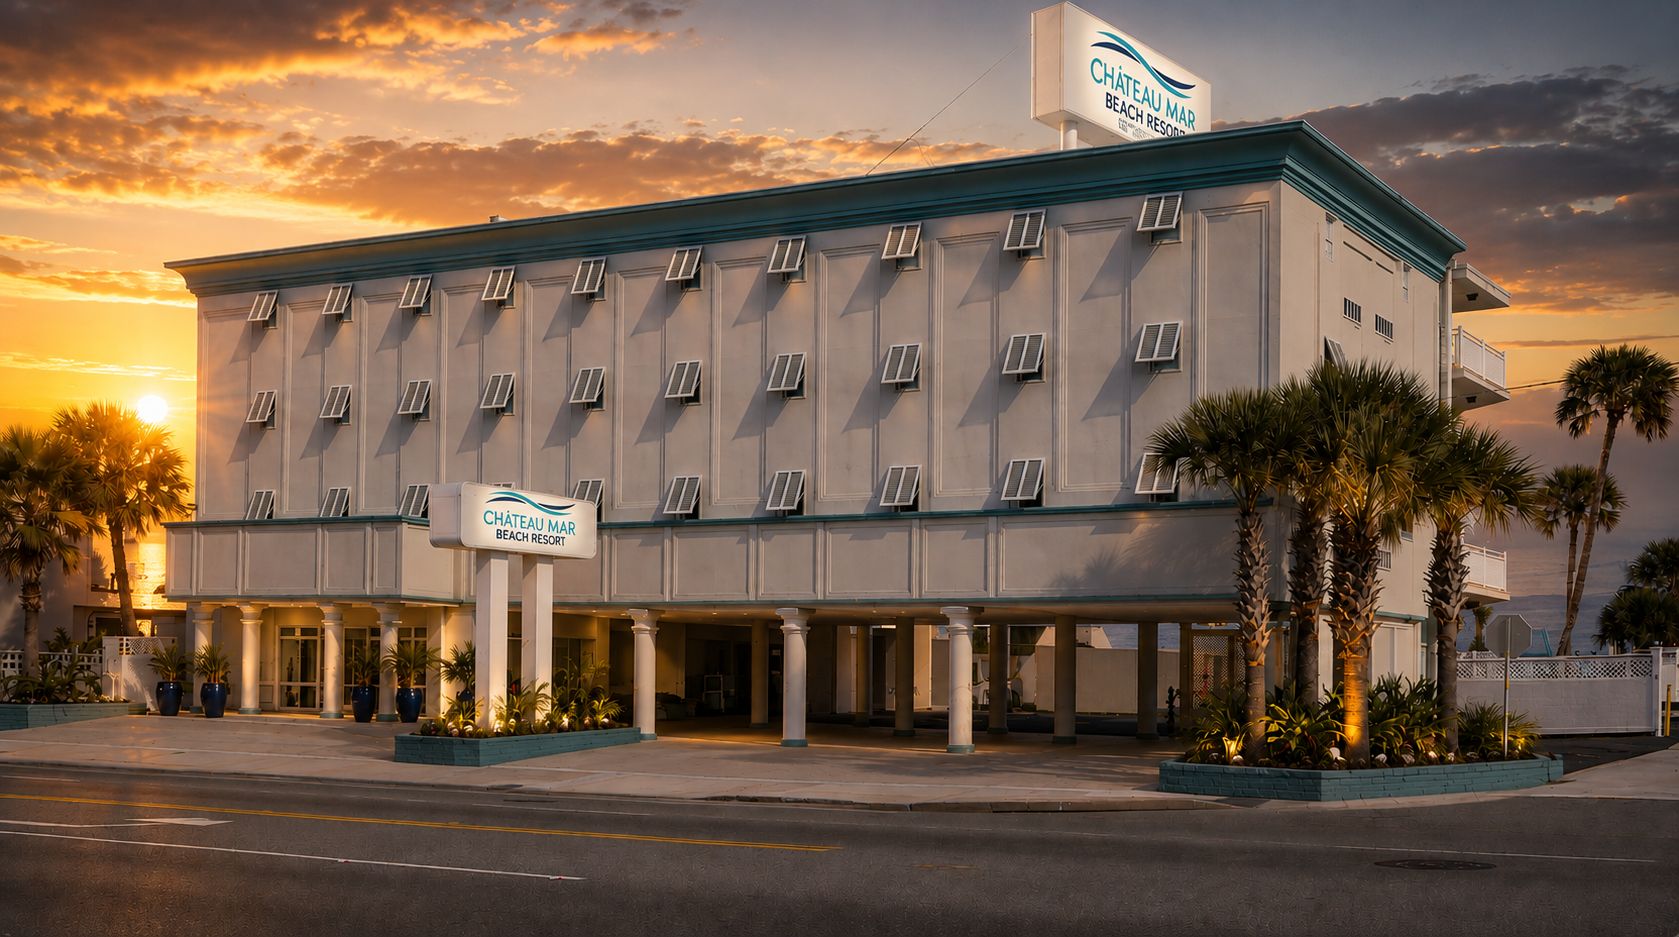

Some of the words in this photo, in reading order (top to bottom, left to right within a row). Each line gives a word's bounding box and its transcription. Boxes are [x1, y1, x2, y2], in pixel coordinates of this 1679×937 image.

[1105, 92, 1143, 124] BEACH
[1165, 98, 1196, 131] MAR
[496, 529, 529, 542] BEACH
[531, 533, 566, 546] RESORT
[548, 519, 576, 536] MAR
